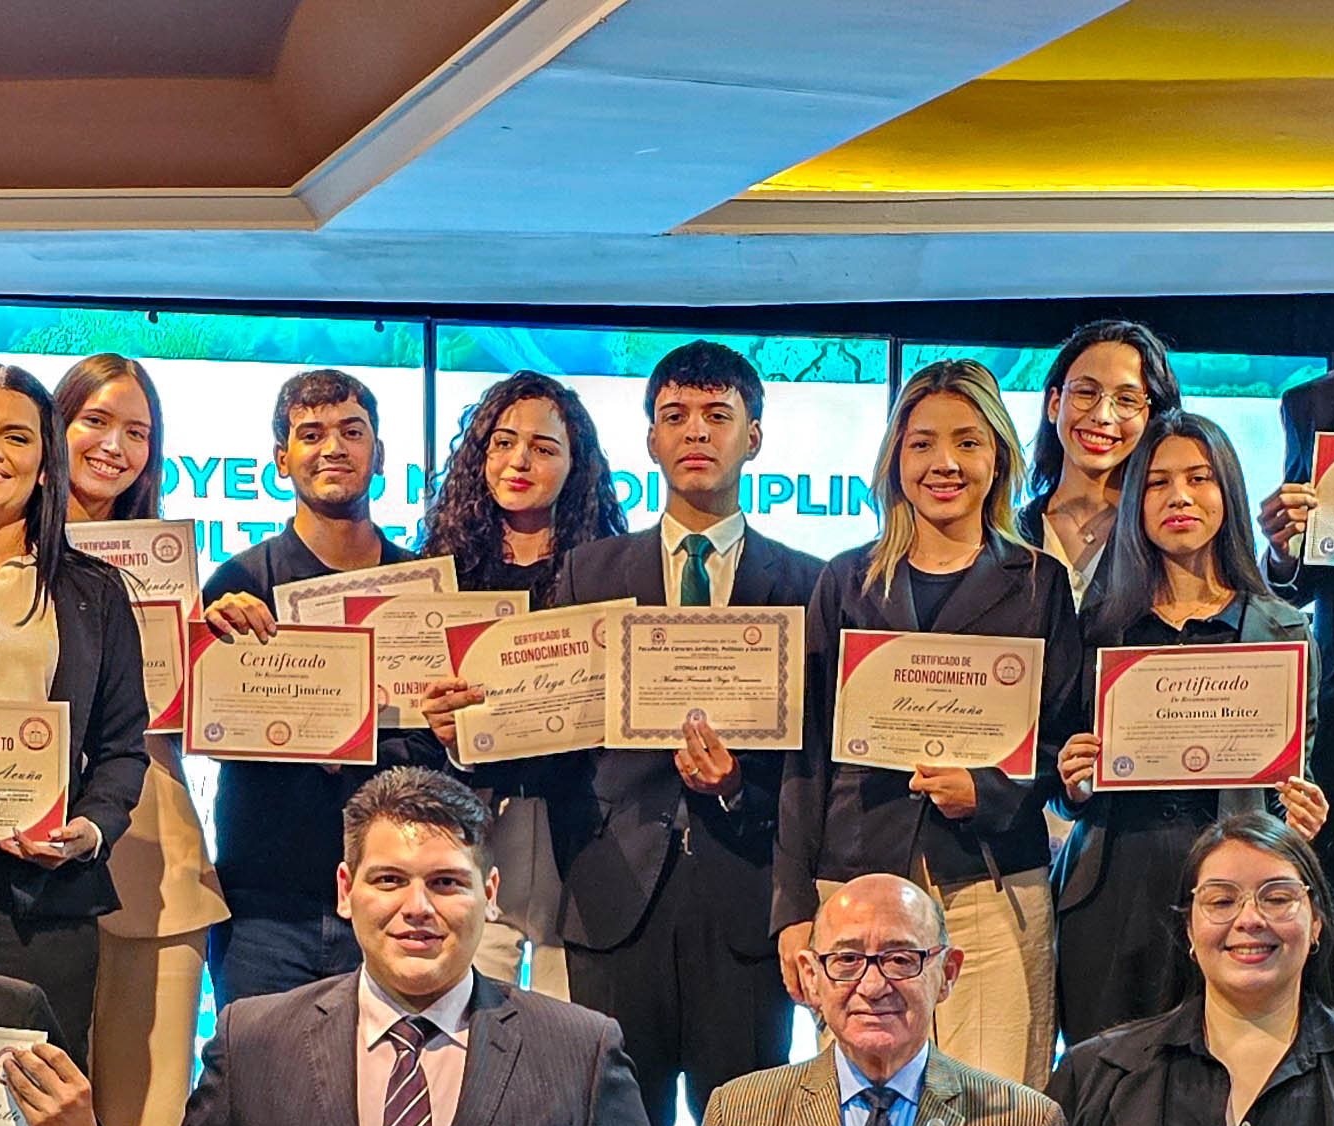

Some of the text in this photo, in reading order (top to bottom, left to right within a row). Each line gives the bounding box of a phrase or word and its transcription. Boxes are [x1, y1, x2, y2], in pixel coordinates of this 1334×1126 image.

[75, 540, 131, 550] CERTIFICADO DE
[514, 628, 571, 645] CERTIFICADO DE
[240, 651, 326, 672] Certificado
[501, 641, 589, 666] RECONOCIMIENTO
[911, 654, 971, 667] CERTIFICADO DE
[533, 673, 564, 692] Vega
[894, 668, 987, 686] RECONOCIMIENTO
[1156, 675, 1249, 696] Certificado
[242, 683, 291, 697] Ezequiel
[937, 698, 983, 716] Acuña
[1156, 707, 1216, 719] Giovanna
